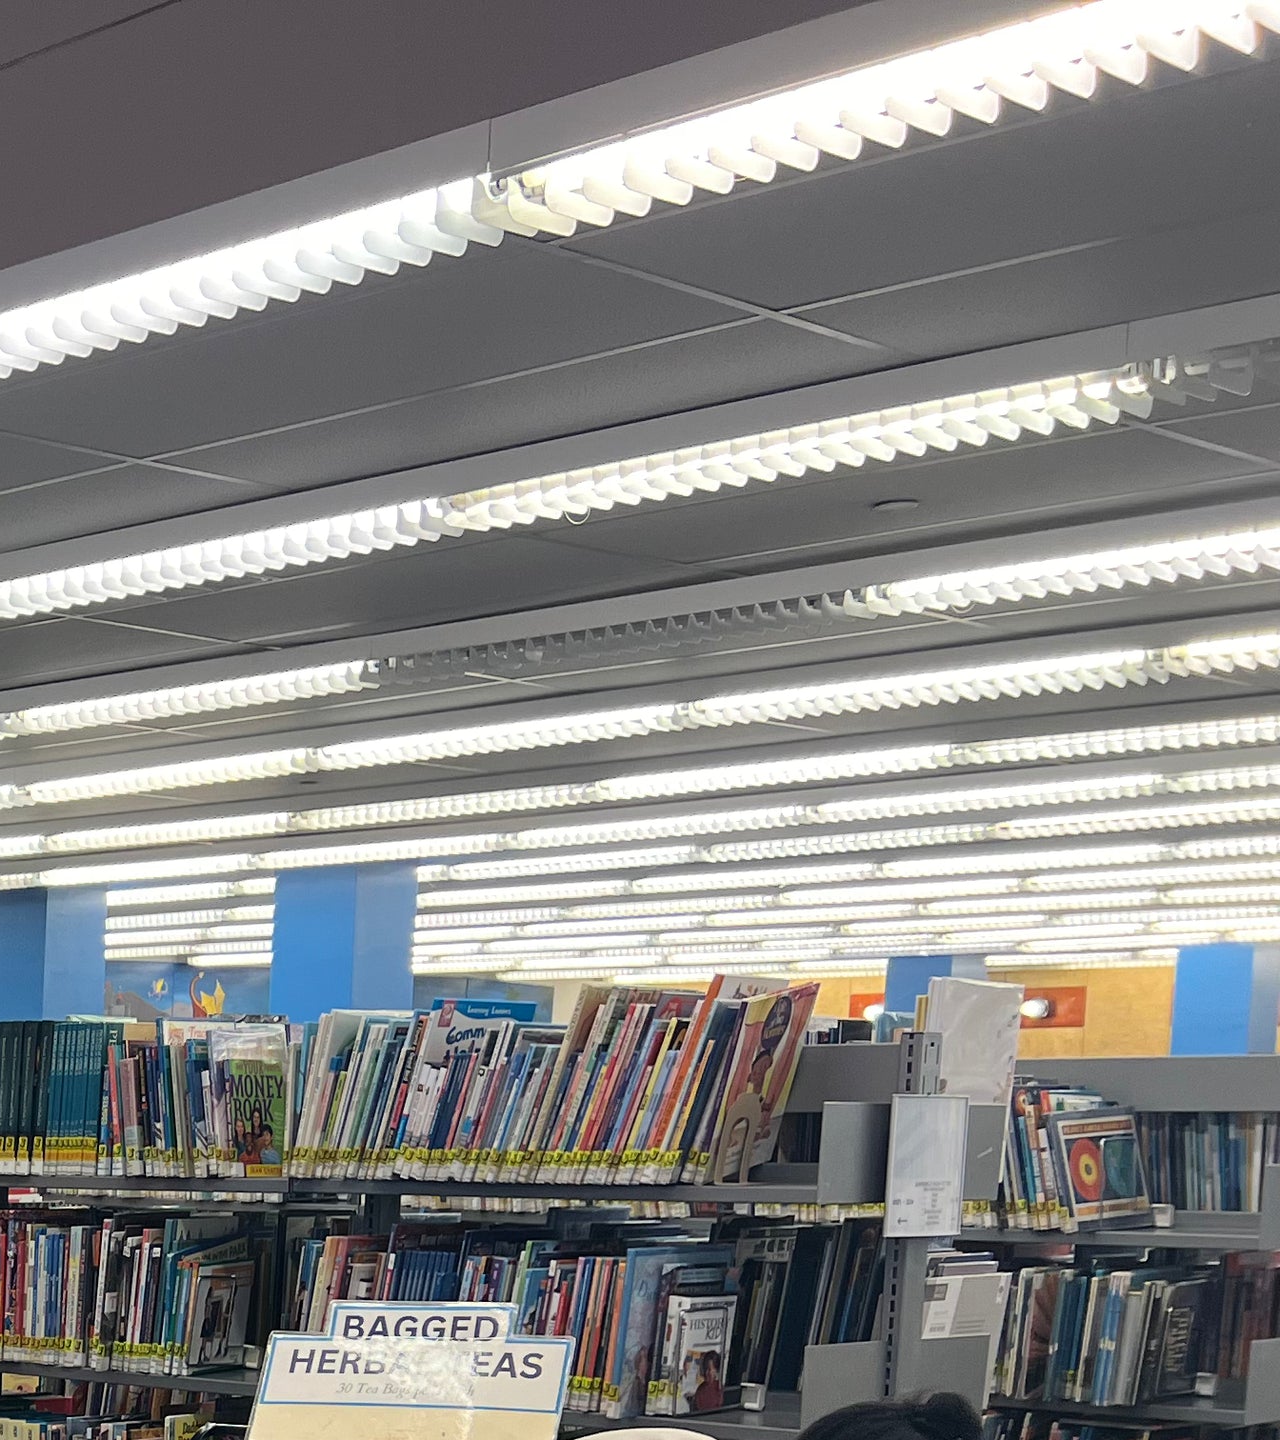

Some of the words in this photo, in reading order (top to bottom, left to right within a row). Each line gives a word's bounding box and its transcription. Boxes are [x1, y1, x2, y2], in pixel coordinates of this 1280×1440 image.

[446, 1026, 486, 1045] Comm
[230, 1073, 283, 1098] MONEY
[232, 1099, 274, 1123] BOOK
[342, 1315, 500, 1342] BAGGED
[690, 1317, 727, 1331] HISTOR
[289, 1349, 412, 1376] HERB
[470, 1351, 544, 1379] EAS
[336, 1382, 353, 1394] 30
[356, 1382, 378, 1395] Tea
